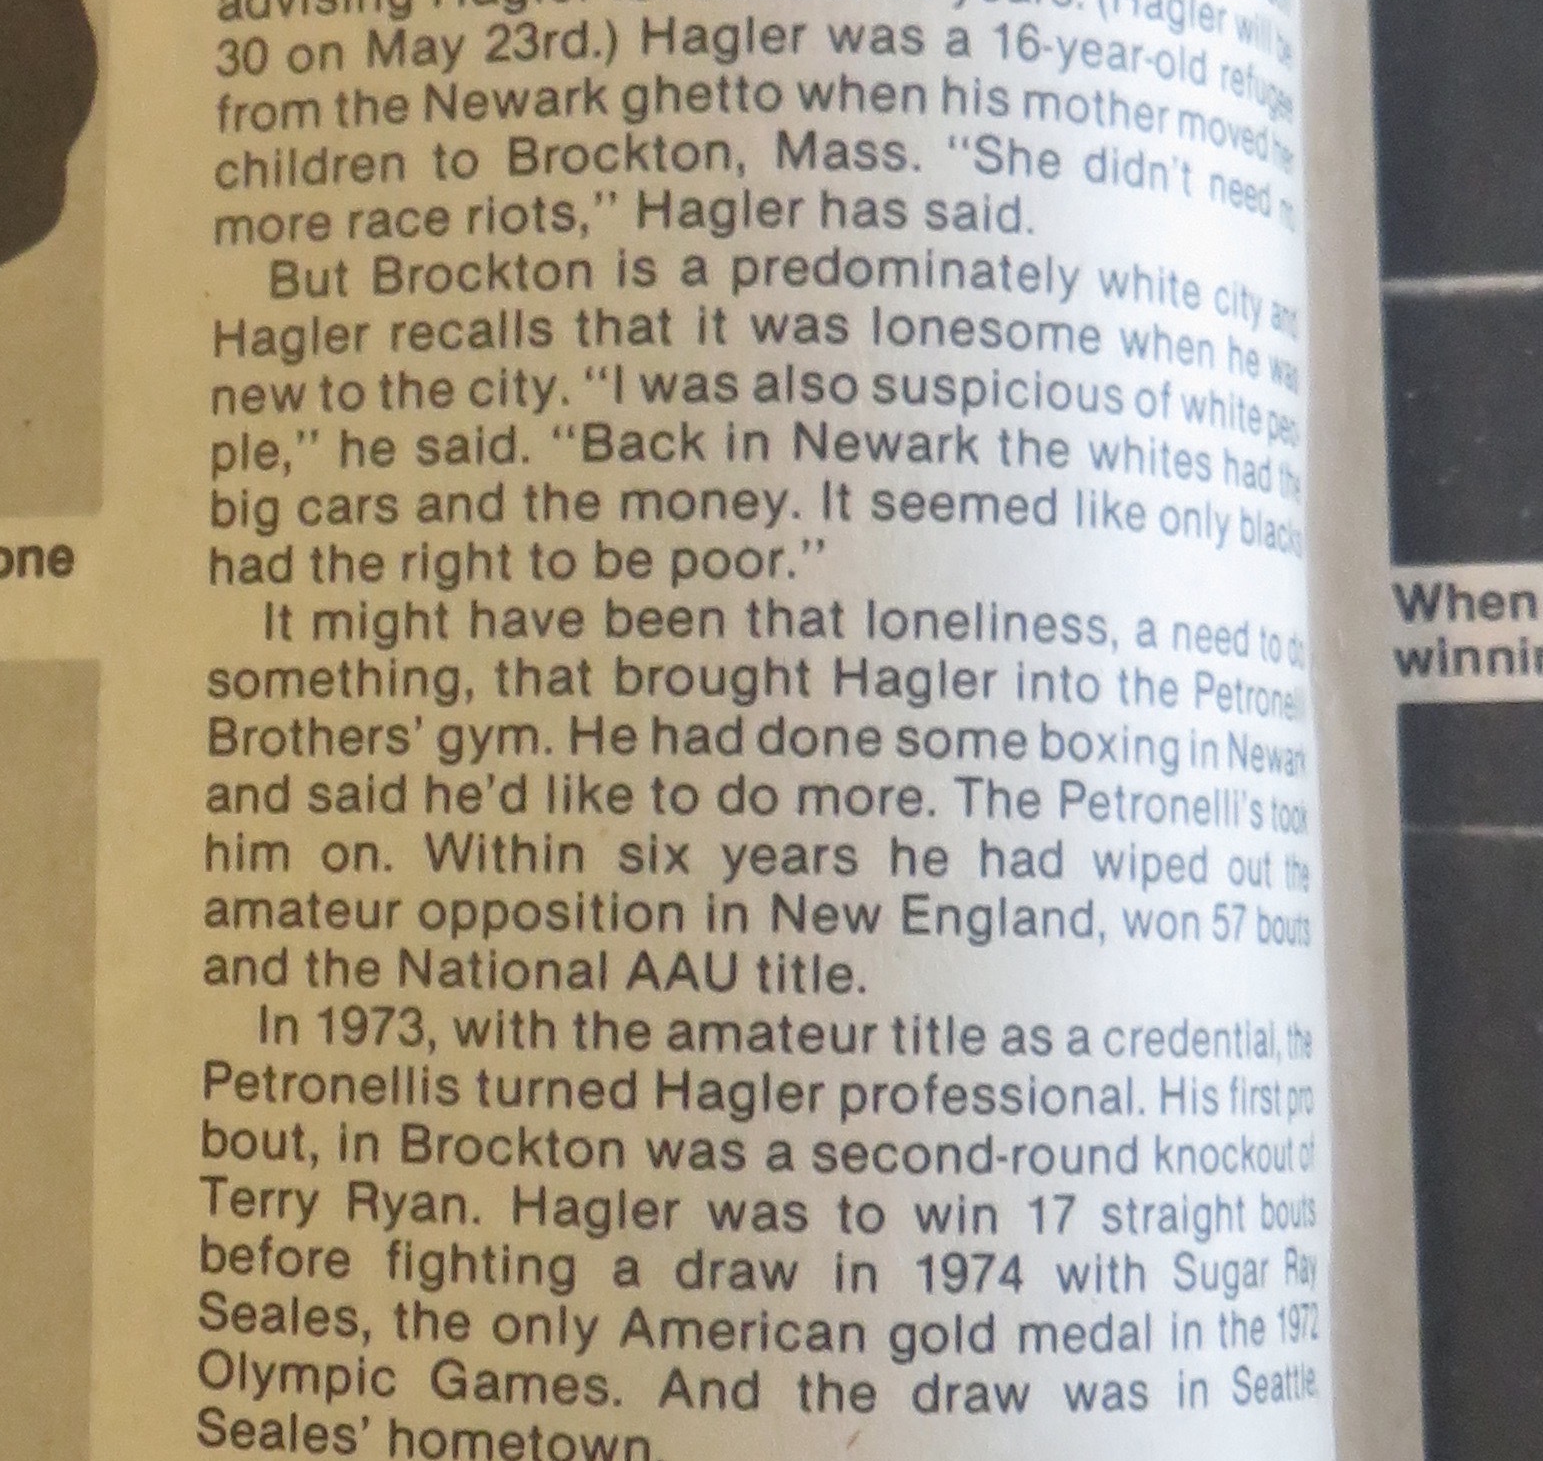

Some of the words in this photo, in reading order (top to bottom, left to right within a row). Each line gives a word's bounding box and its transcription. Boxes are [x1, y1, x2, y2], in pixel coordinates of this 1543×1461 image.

[214, 210, 332, 246] more
[348, 205, 451, 240] race
[467, 190, 617, 238] riots,"
[637, 188, 805, 240] Hagler
[820, 189, 908, 230] has
[925, 195, 1035, 235] said.
[209, 544, 294, 586] had
[309, 543, 385, 585] the
[401, 540, 512, 593] right
[529, 542, 577, 582] to
[594, 538, 654, 580] be
[670, 538, 821, 589] poor."
[1392, 582, 1538, 623] When
[203, 946, 289, 987] and
[305, 947, 381, 989] the
[398, 947, 608, 992] National
[625, 949, 738, 994] AAU
[756, 952, 866, 995] title.
[259, 1003, 299, 1046] In
[317, 1004, 437, 1055] 1973,
[453, 1008, 556, 1050] with
[666, 1015, 877, 1056] amateur
[890, 1014, 987, 1057] title
[999, 1023, 1054, 1059] as
[1066, 1024, 1091, 1057] a
[1104, 1017, 1283, 1062] credential,
[199, 1174, 320, 1230] Terry
[347, 1179, 481, 1233] Ryan.
[512, 1184, 681, 1240] Hagler
[707, 1199, 809, 1234] was
[837, 1194, 886, 1235] to
[914, 1194, 998, 1235] win
[1028, 1193, 1077, 1235] 17
[1102, 1194, 1245, 1244] straight
[1260, 1192, 1316, 1231] bouts
[196, 1405, 370, 1456] Seales'
